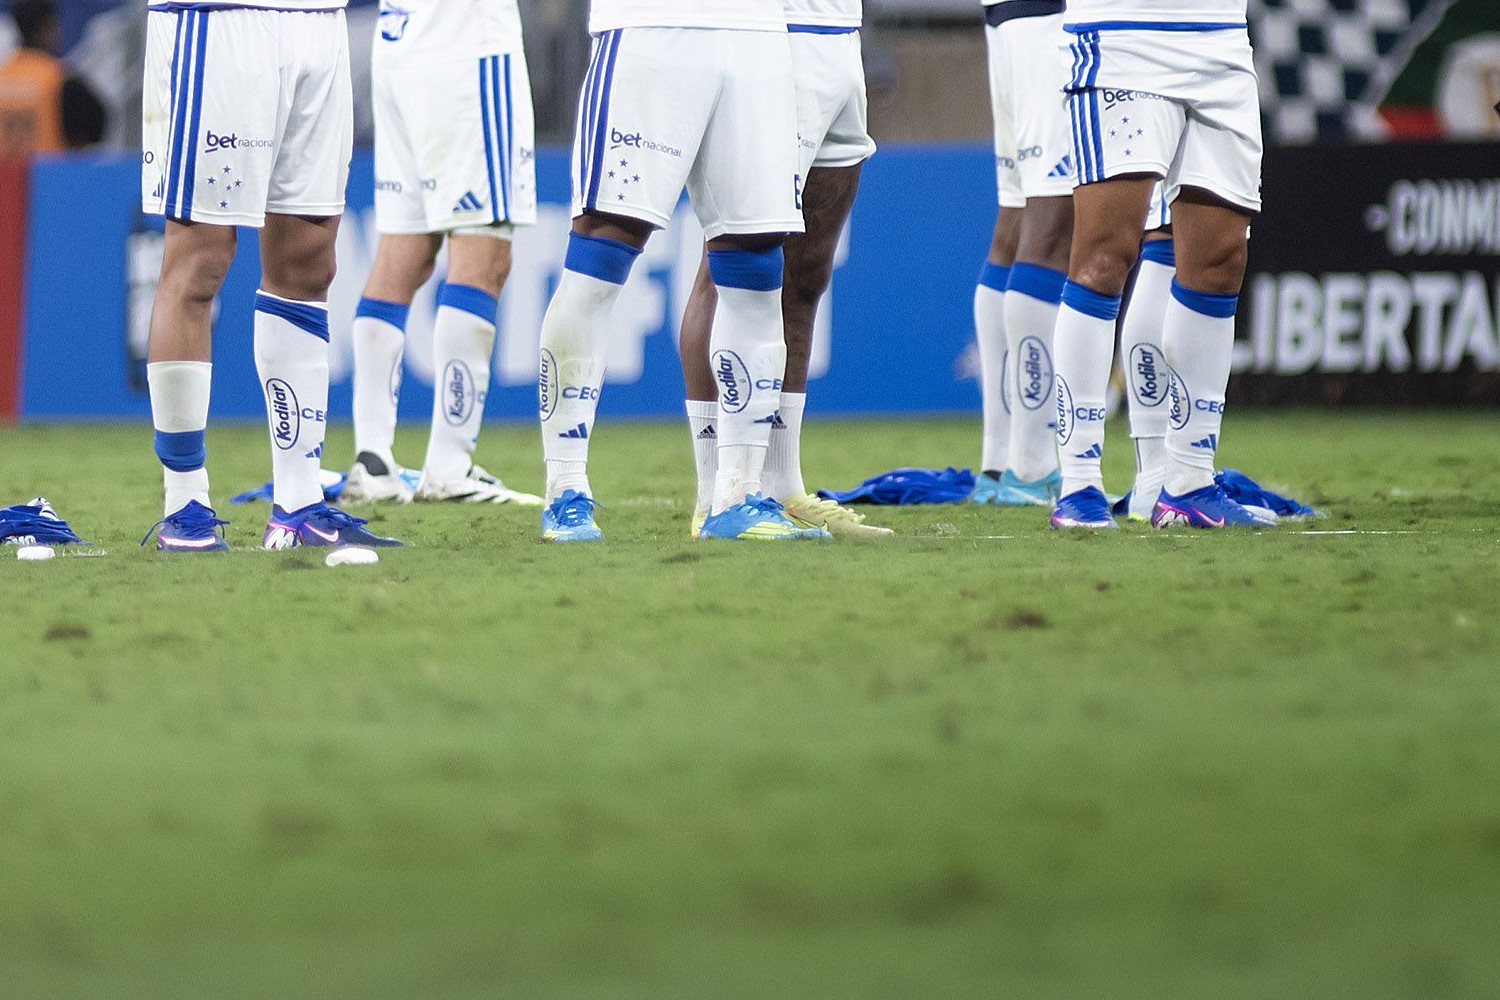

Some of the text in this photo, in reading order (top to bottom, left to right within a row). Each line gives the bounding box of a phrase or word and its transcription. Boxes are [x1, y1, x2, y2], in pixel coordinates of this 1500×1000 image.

[206, 131, 274, 149] bet naciona
[611, 128, 682, 158] bet nacional
[1231, 270, 1500, 375] IBERTA
[717, 354, 739, 407] Kodilar
[1025, 342, 1041, 401] Kodilar
[1138, 347, 1157, 400] Kodilar
[272, 383, 291, 441] Kodilar
[1076, 407, 1105, 421] CEC
